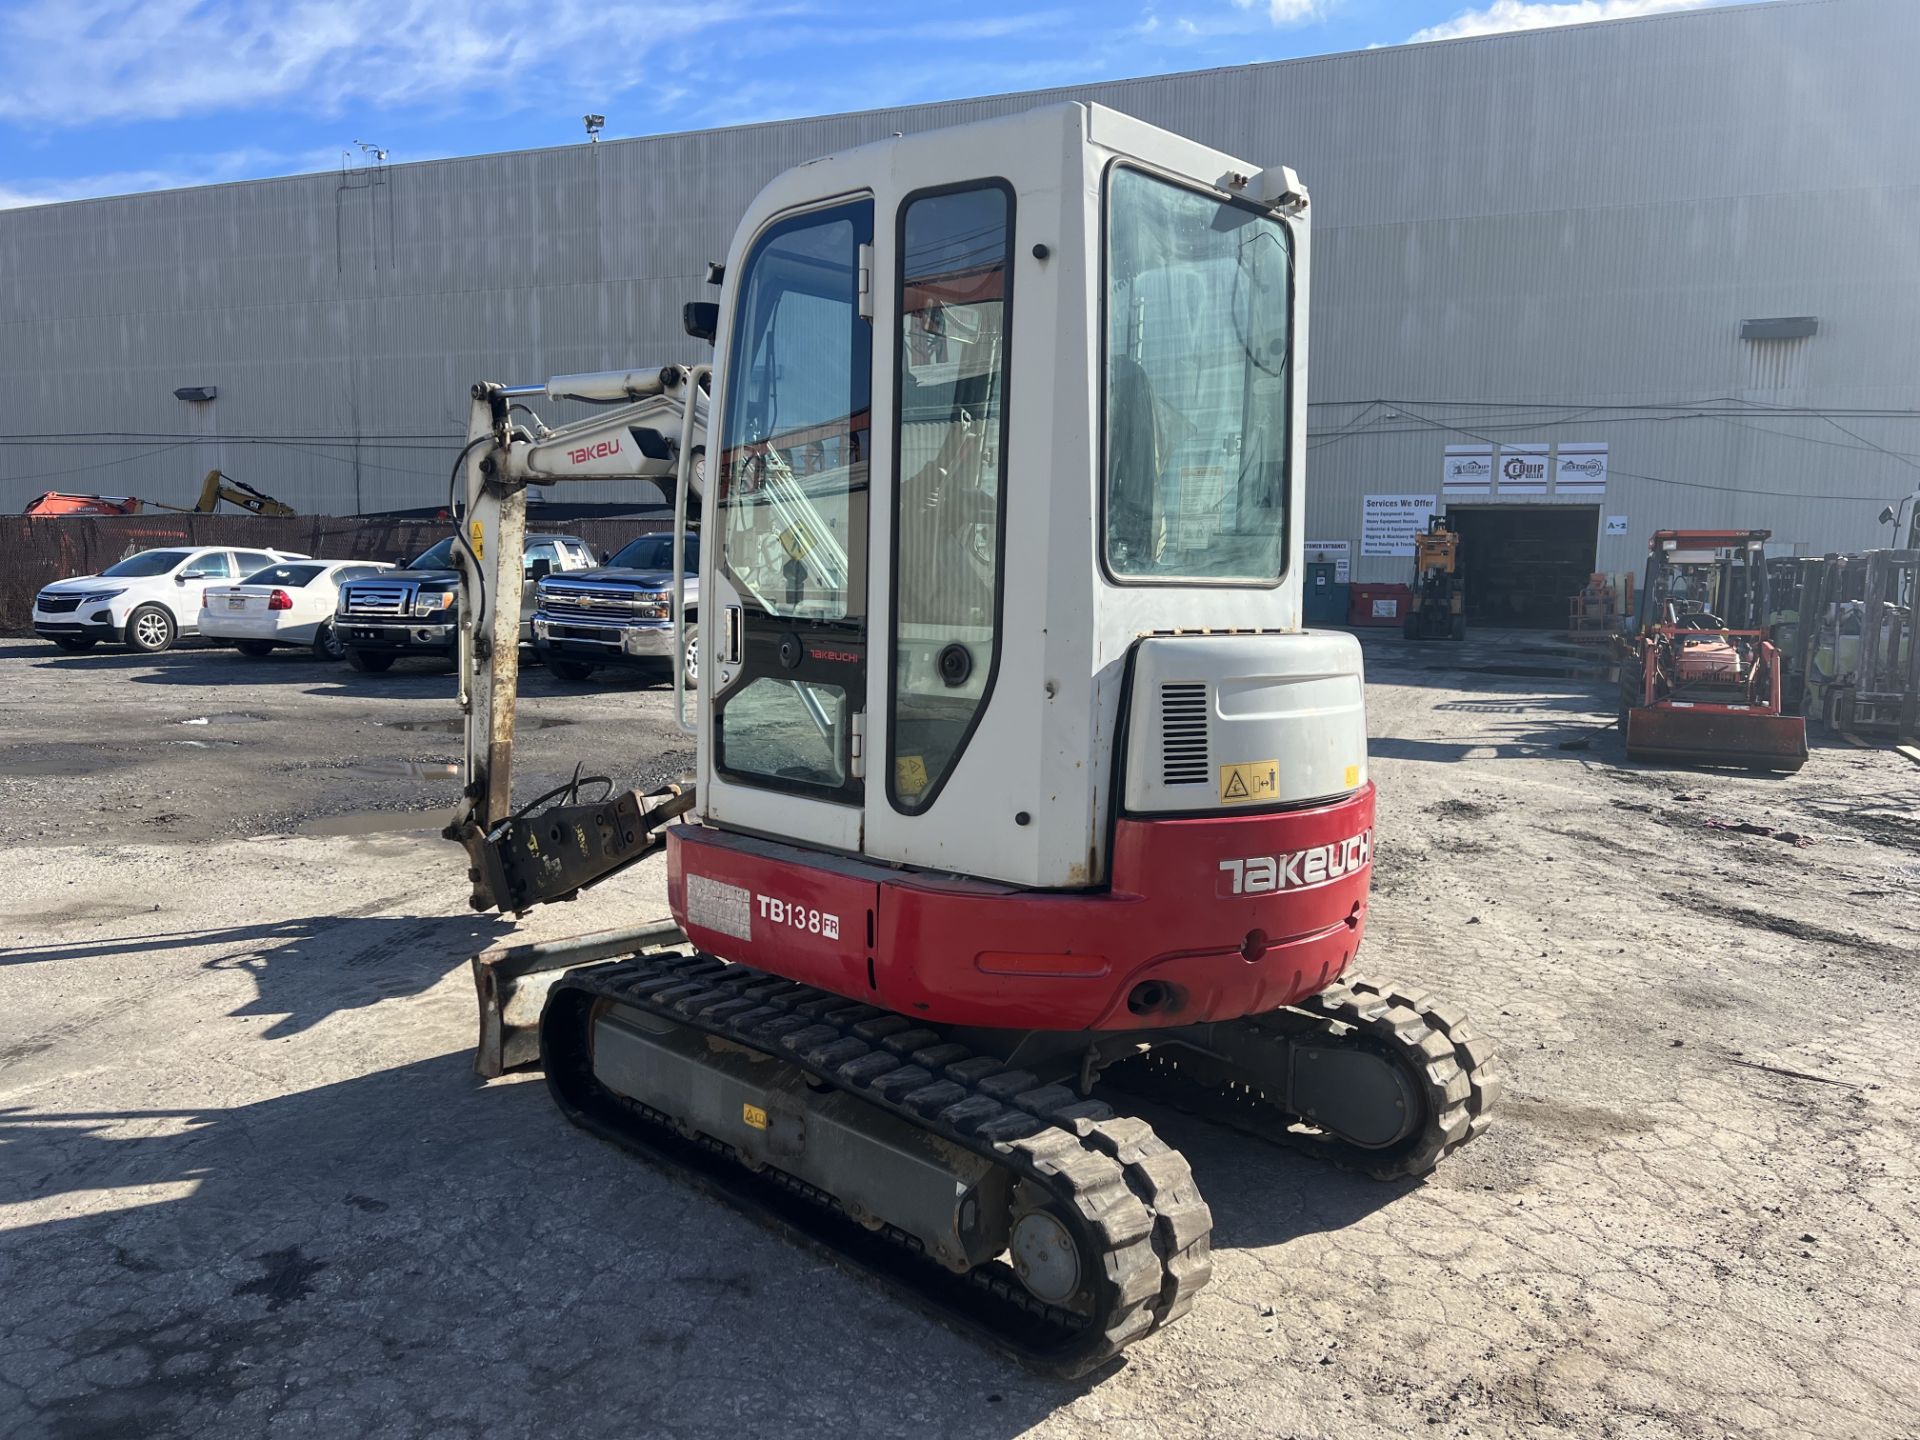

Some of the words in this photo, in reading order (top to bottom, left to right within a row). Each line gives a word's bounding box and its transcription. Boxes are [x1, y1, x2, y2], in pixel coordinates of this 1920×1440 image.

[1512, 464, 1544, 474] EQUIP
[1366, 499, 1398, 508] Services
[1400, 499, 1413, 508] We
[1414, 499, 1434, 508] Offer
[1607, 521, 1627, 529] A-2
